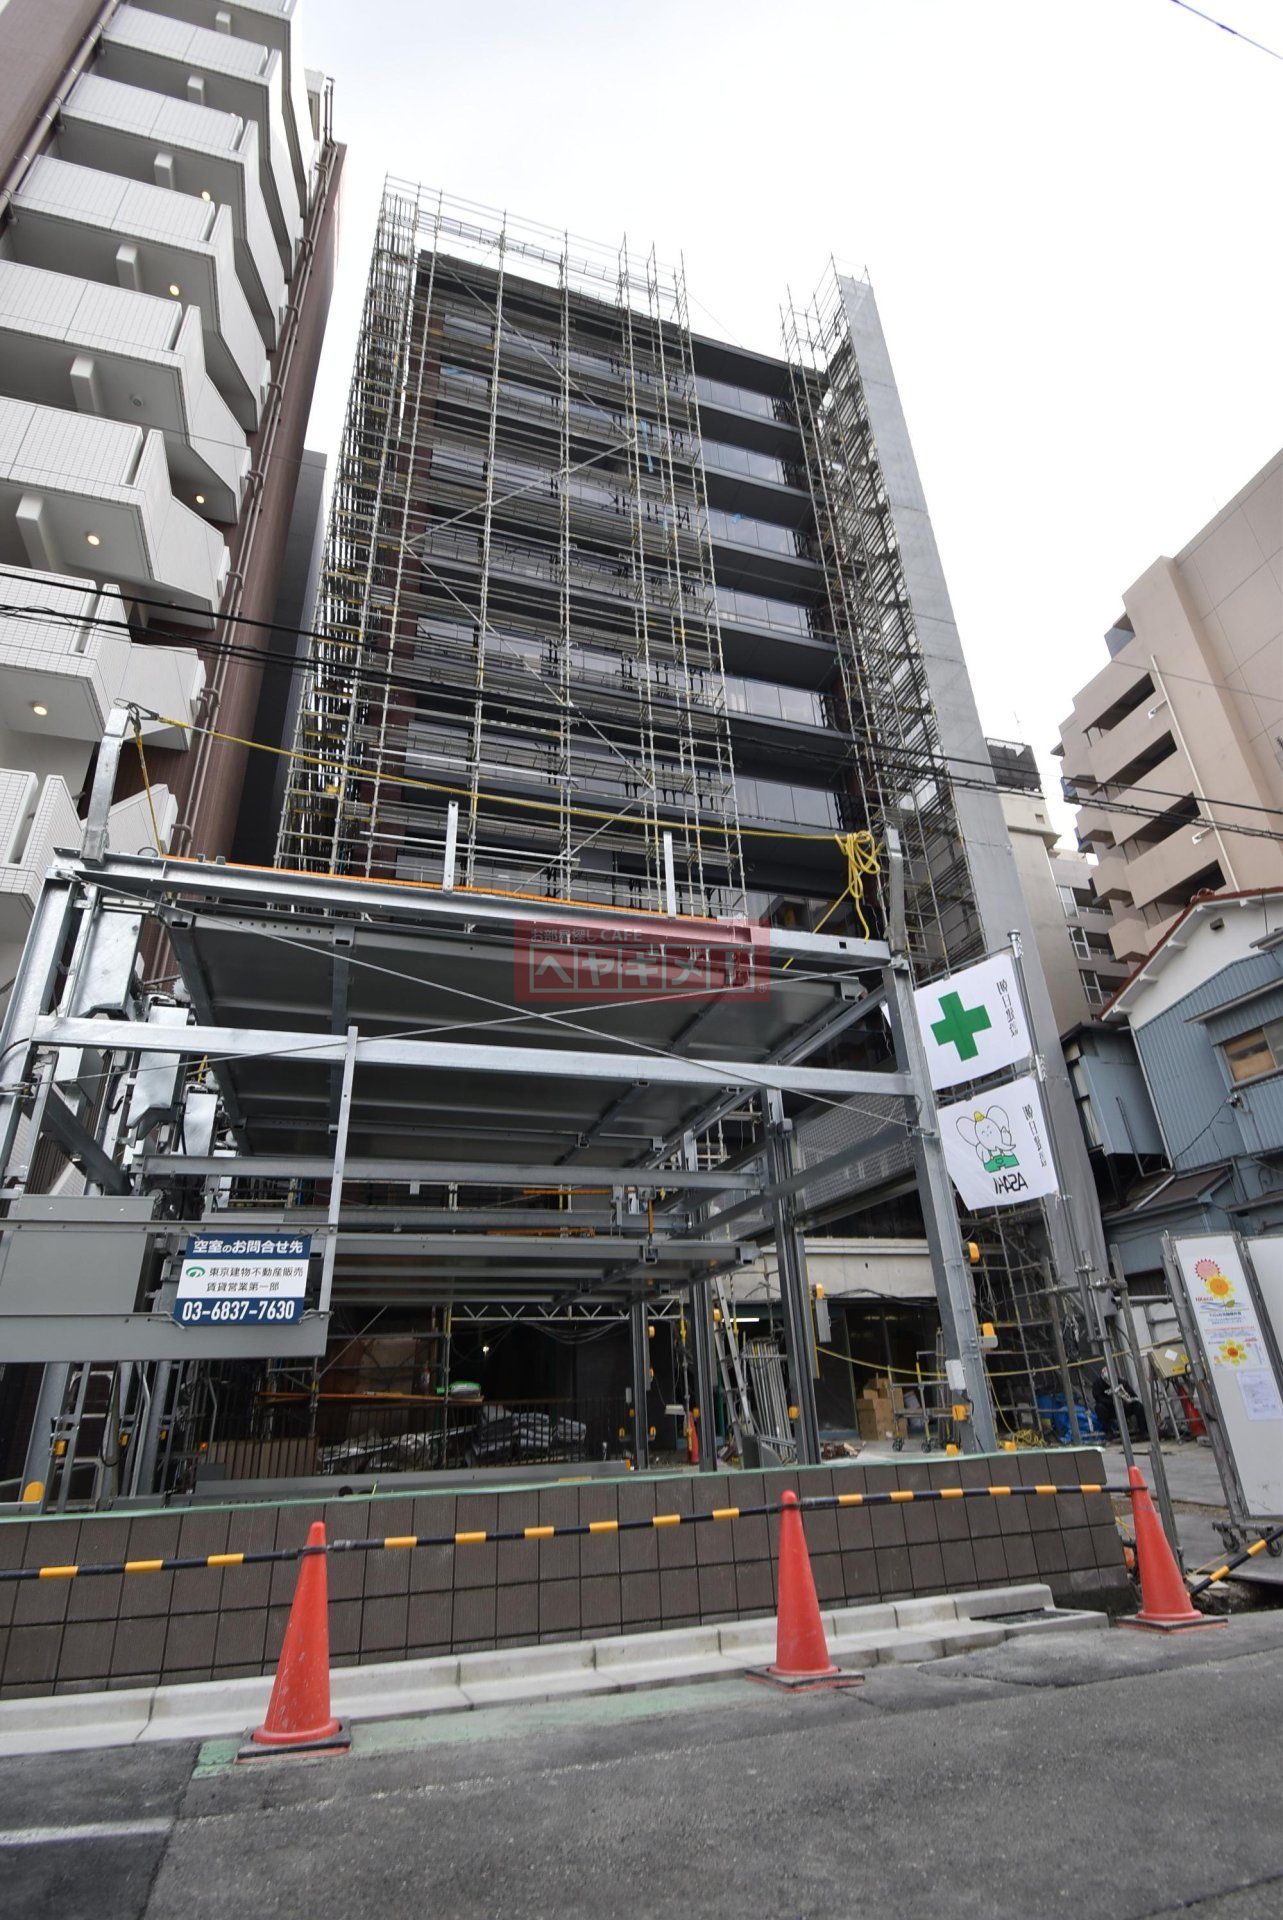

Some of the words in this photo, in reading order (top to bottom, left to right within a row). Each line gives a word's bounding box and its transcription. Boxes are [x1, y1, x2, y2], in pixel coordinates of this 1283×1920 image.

[192, 1239, 304, 1254] 空室のお問合せ先
[209, 1266, 304, 1277] 東京建物不動産販売
[206, 1281, 280, 1292] 賃貸営業第一部
[182, 1300, 295, 1321] 03-6837-7630
